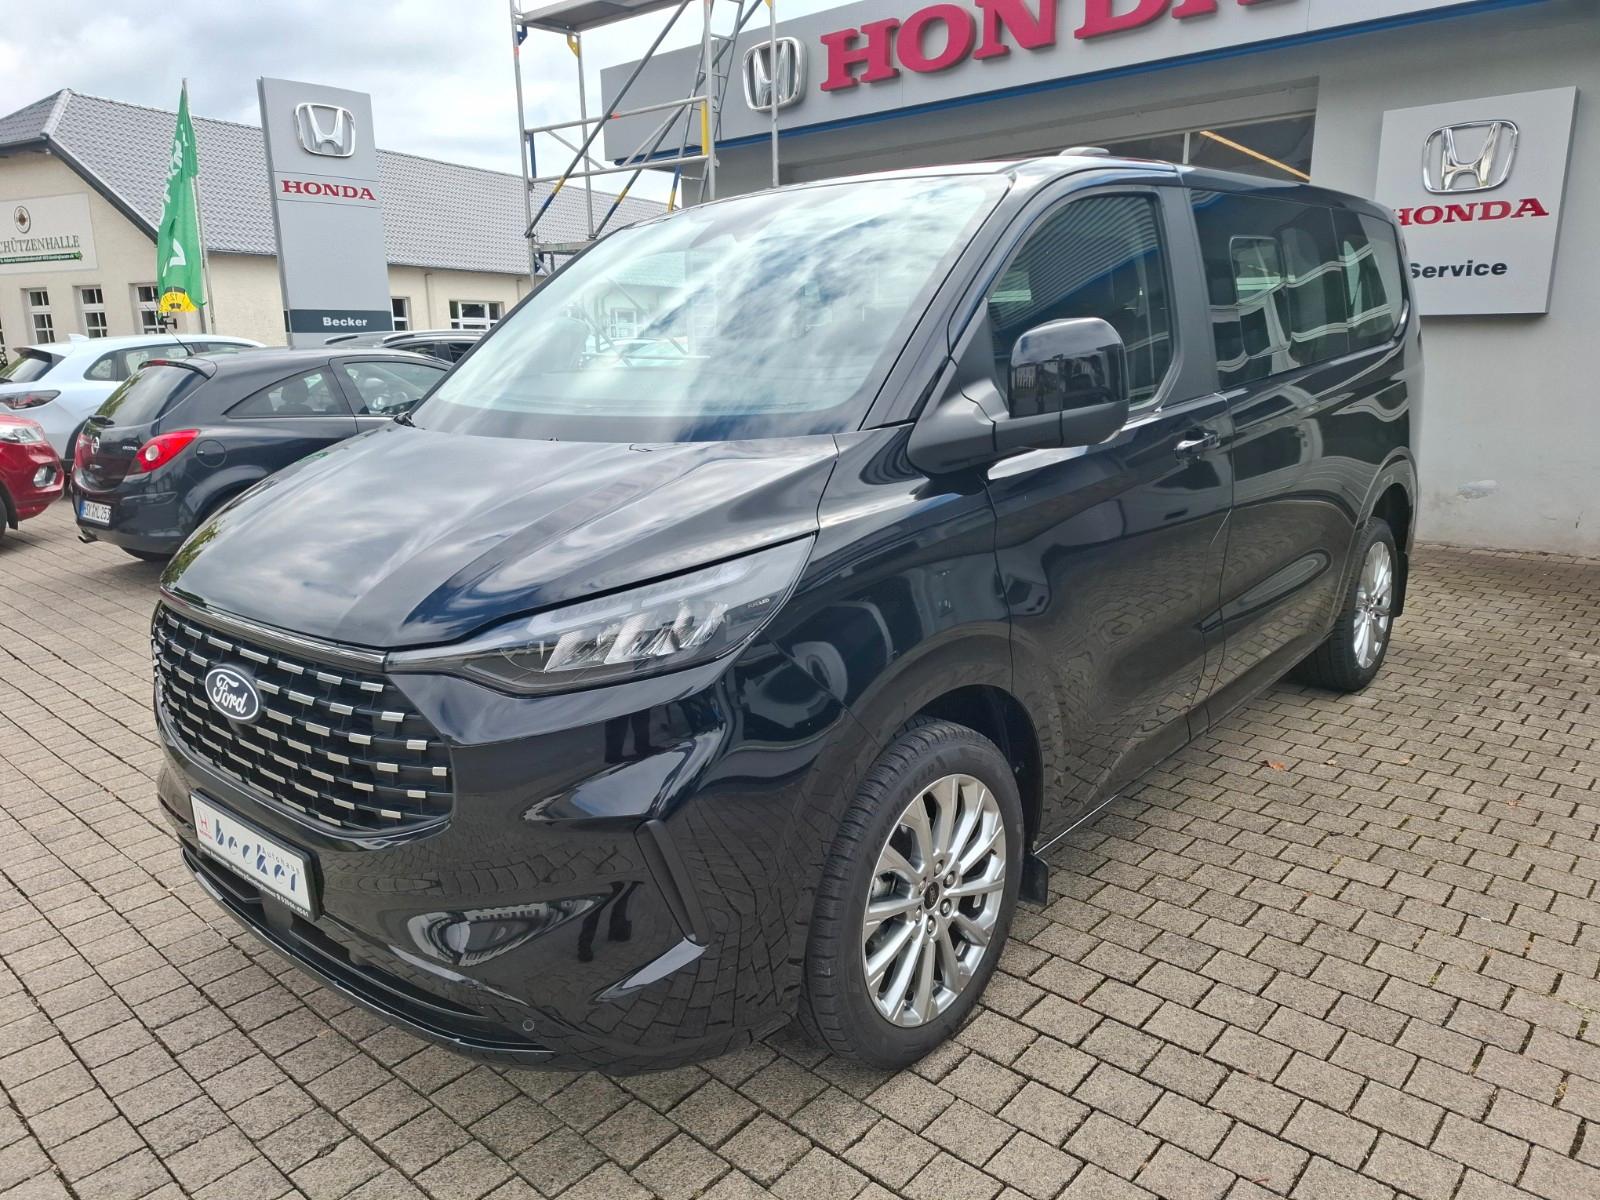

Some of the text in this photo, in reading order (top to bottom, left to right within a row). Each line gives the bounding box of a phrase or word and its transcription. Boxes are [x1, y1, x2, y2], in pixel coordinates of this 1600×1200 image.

[820, 0, 1302, 92] HOND
[281, 180, 376, 201] HONDA
[1392, 197, 1549, 226] HONDA
[1410, 260, 1508, 279] Service
[322, 316, 368, 327] Becker
[213, 674, 248, 714] Ford
[215, 818, 297, 892] becker
